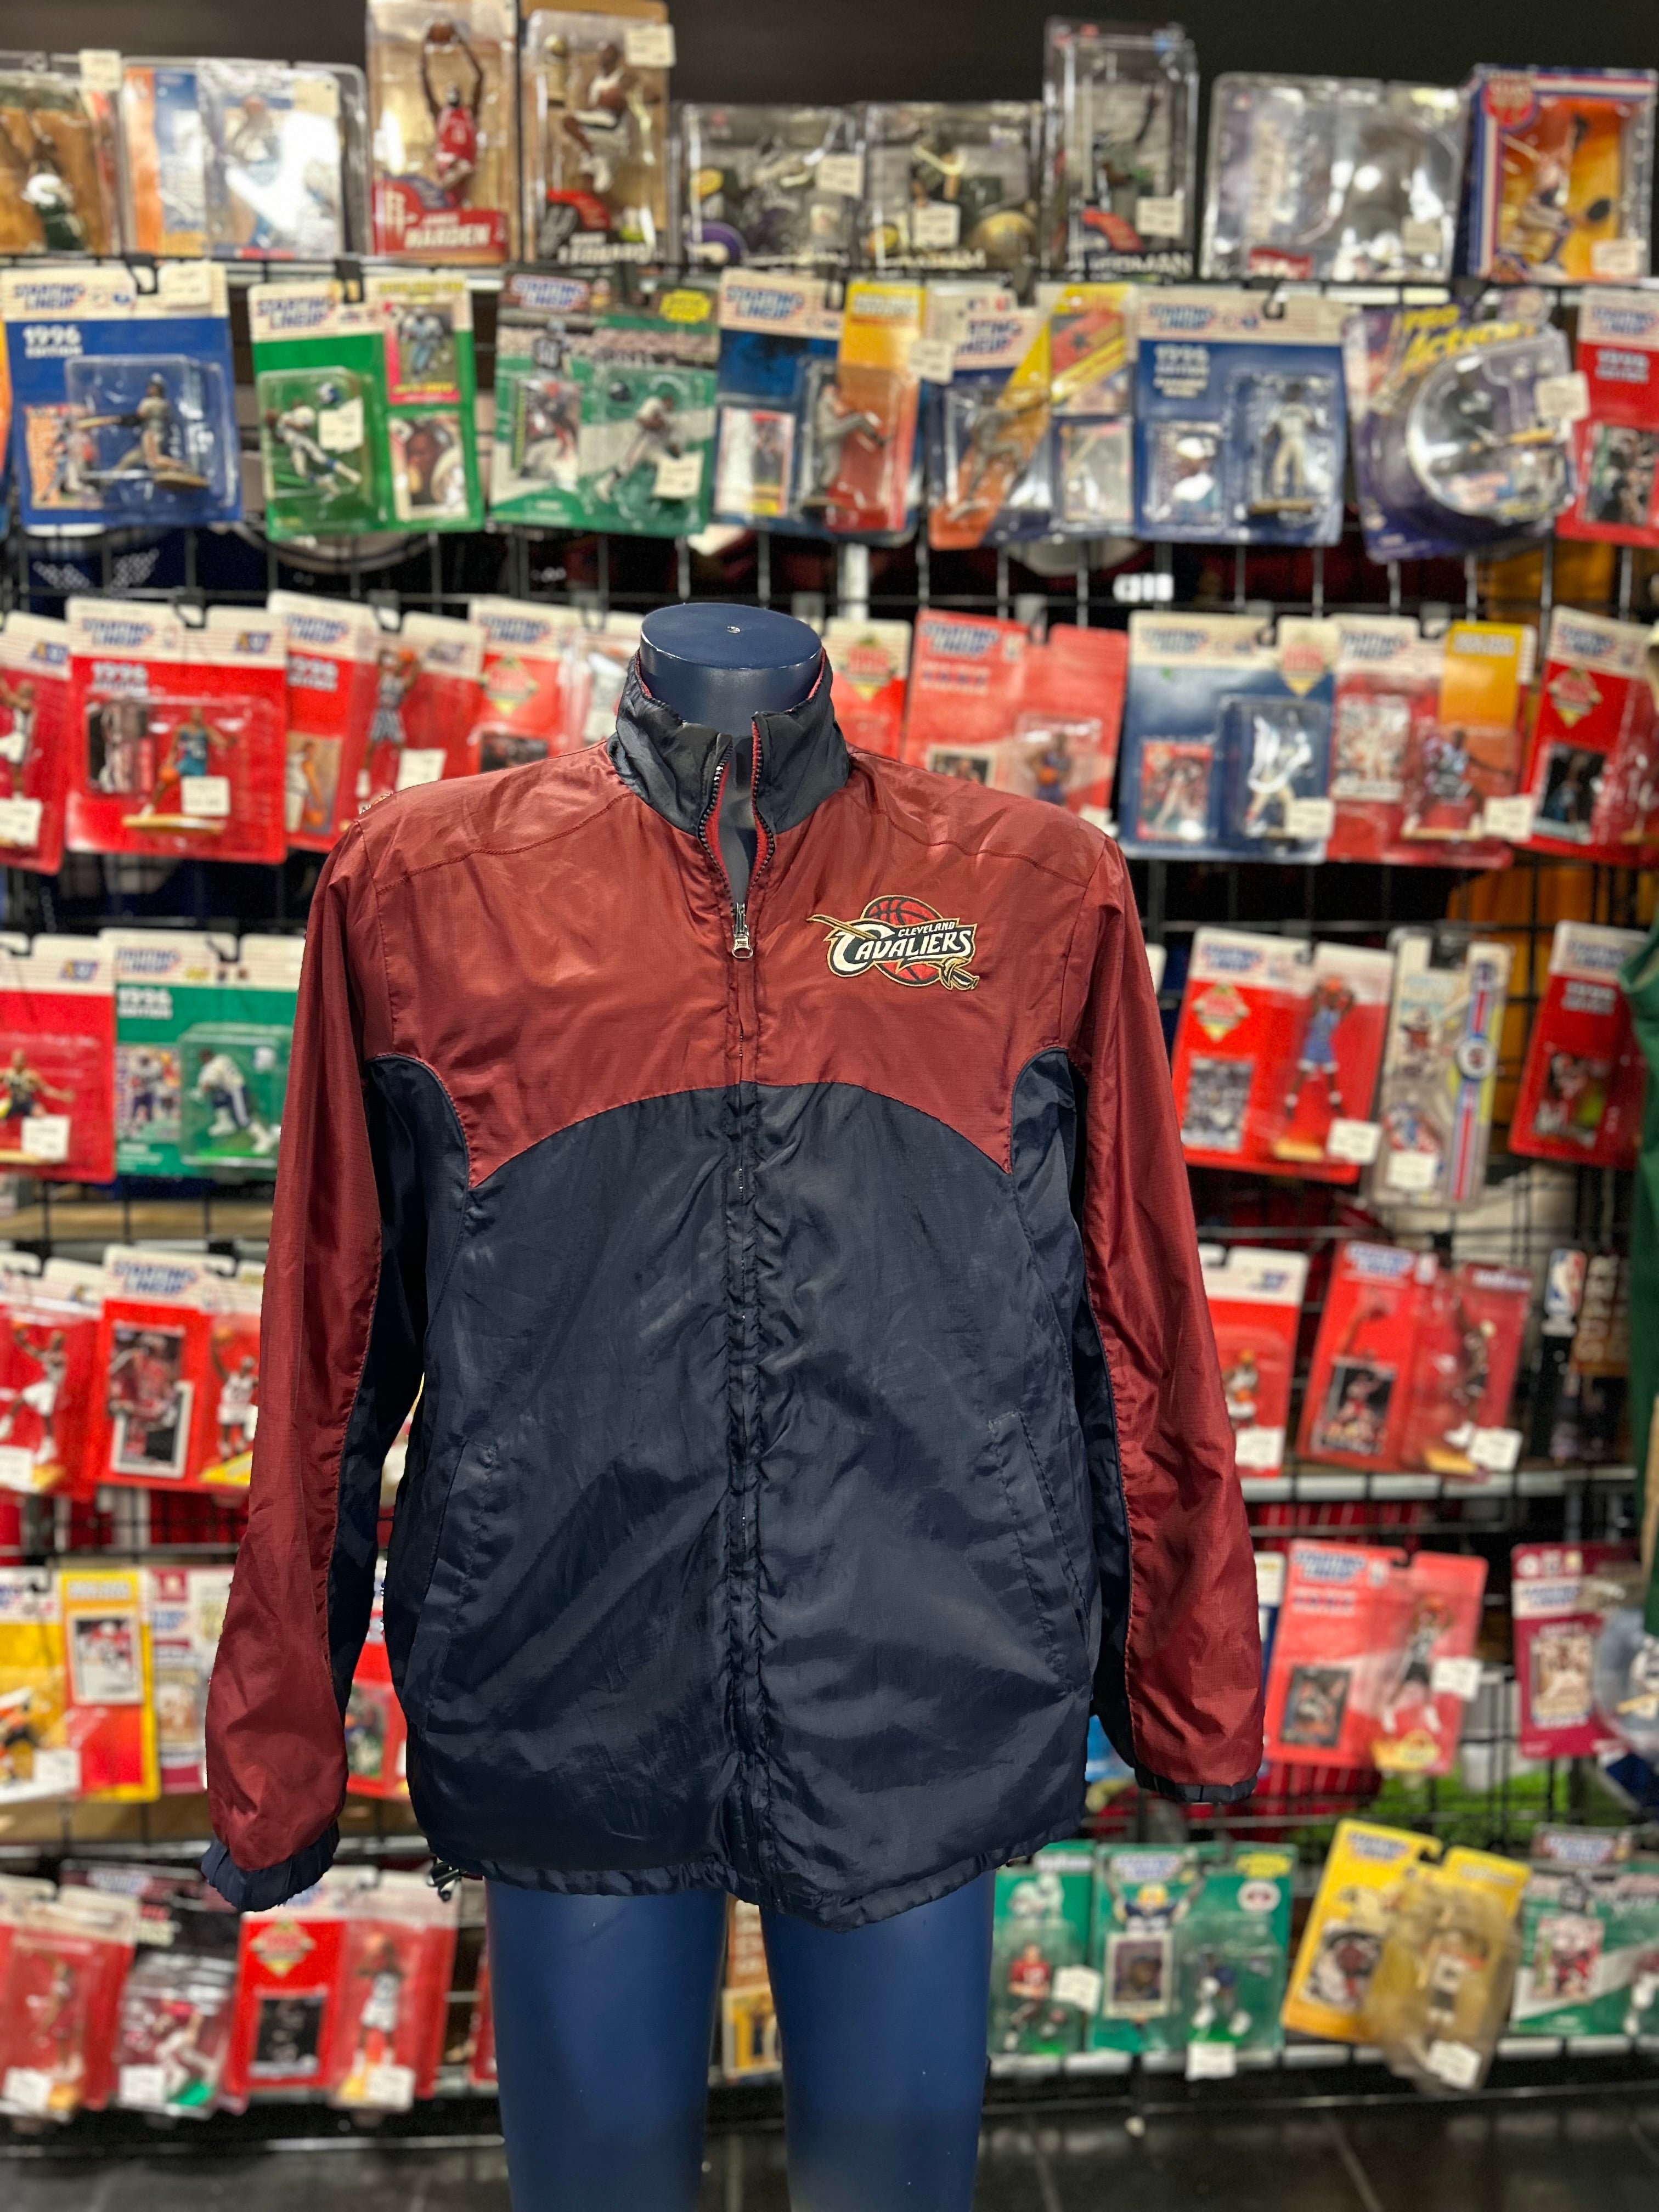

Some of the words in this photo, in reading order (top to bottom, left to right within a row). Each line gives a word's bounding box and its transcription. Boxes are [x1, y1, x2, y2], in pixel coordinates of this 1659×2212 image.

[14, 283, 85, 300] STARTING
[25, 296, 75, 311] LINEUP
[257, 295, 336, 315] STARTING
[269, 311, 327, 329] LINEUP
[22, 325, 81, 347] 1996
[93, 660, 148, 684] 1996
[899, 922, 955, 937] CLEVELAND
[832, 923, 972, 972] CAVALIERS
